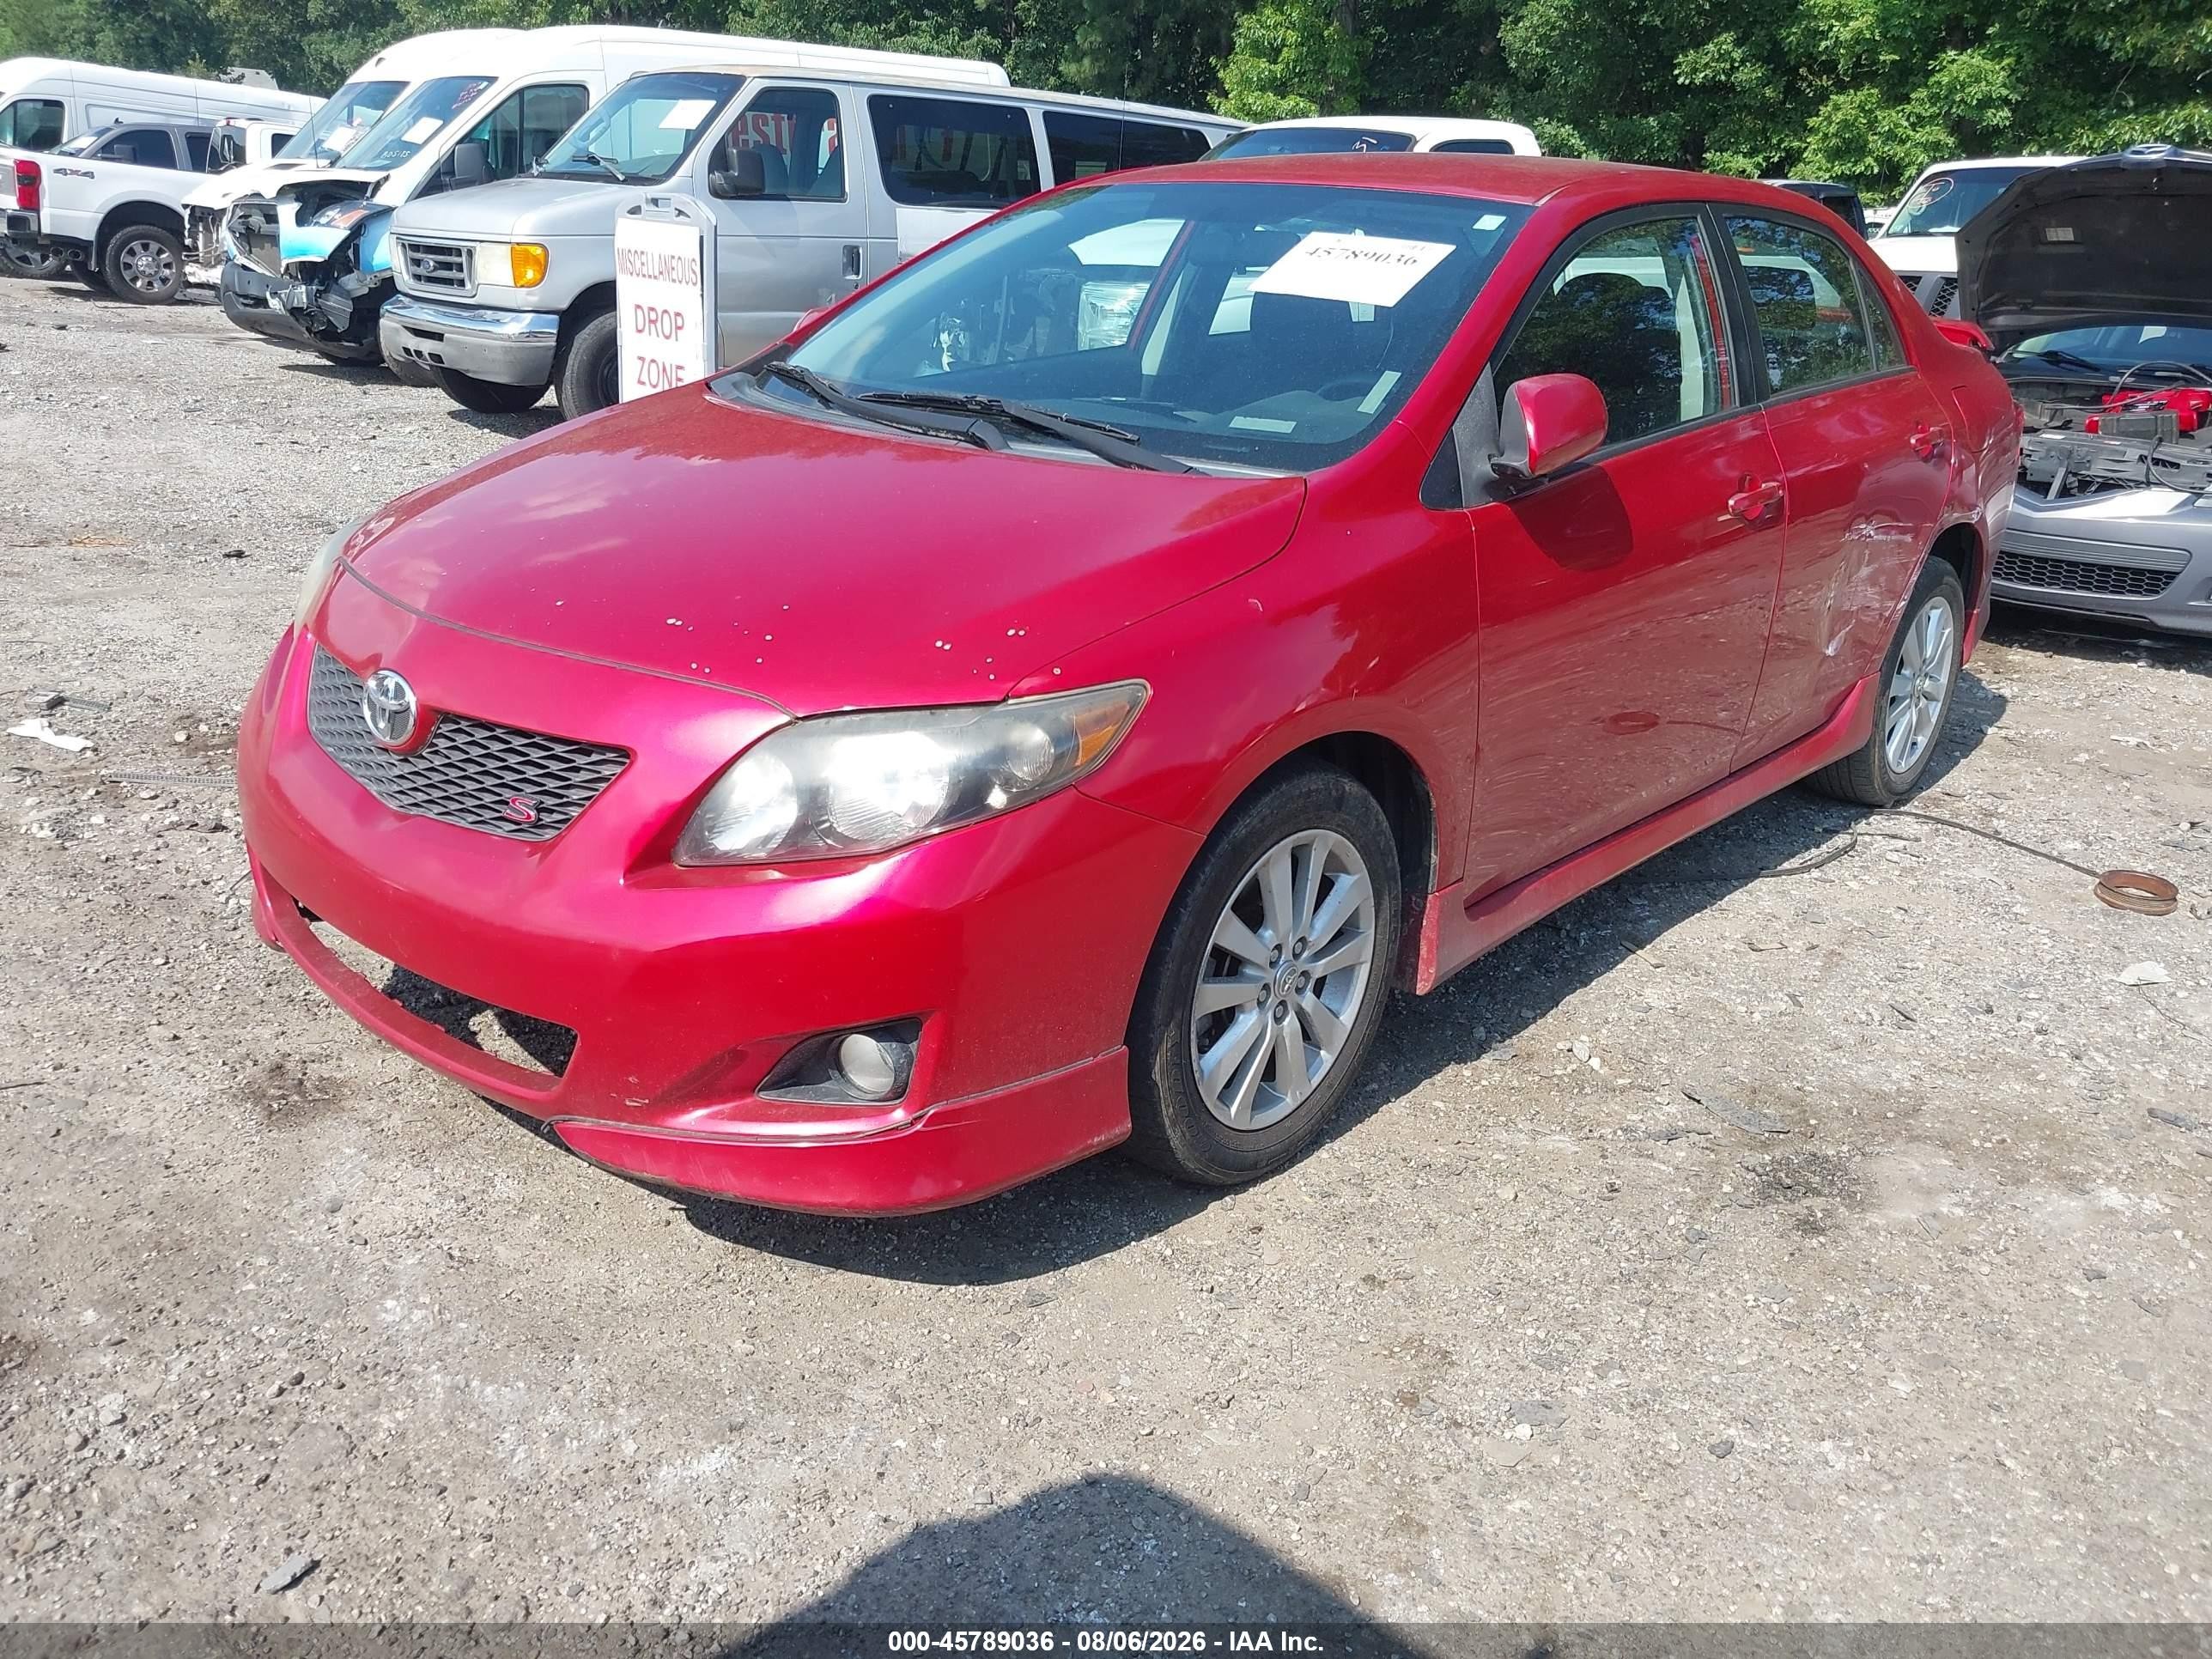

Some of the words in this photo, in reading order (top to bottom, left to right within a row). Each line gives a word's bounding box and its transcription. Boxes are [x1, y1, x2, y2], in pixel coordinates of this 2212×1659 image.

[617, 246, 698, 287] MISCELLANEOUS
[634, 303, 685, 342] DROP
[502, 796, 540, 824] S
